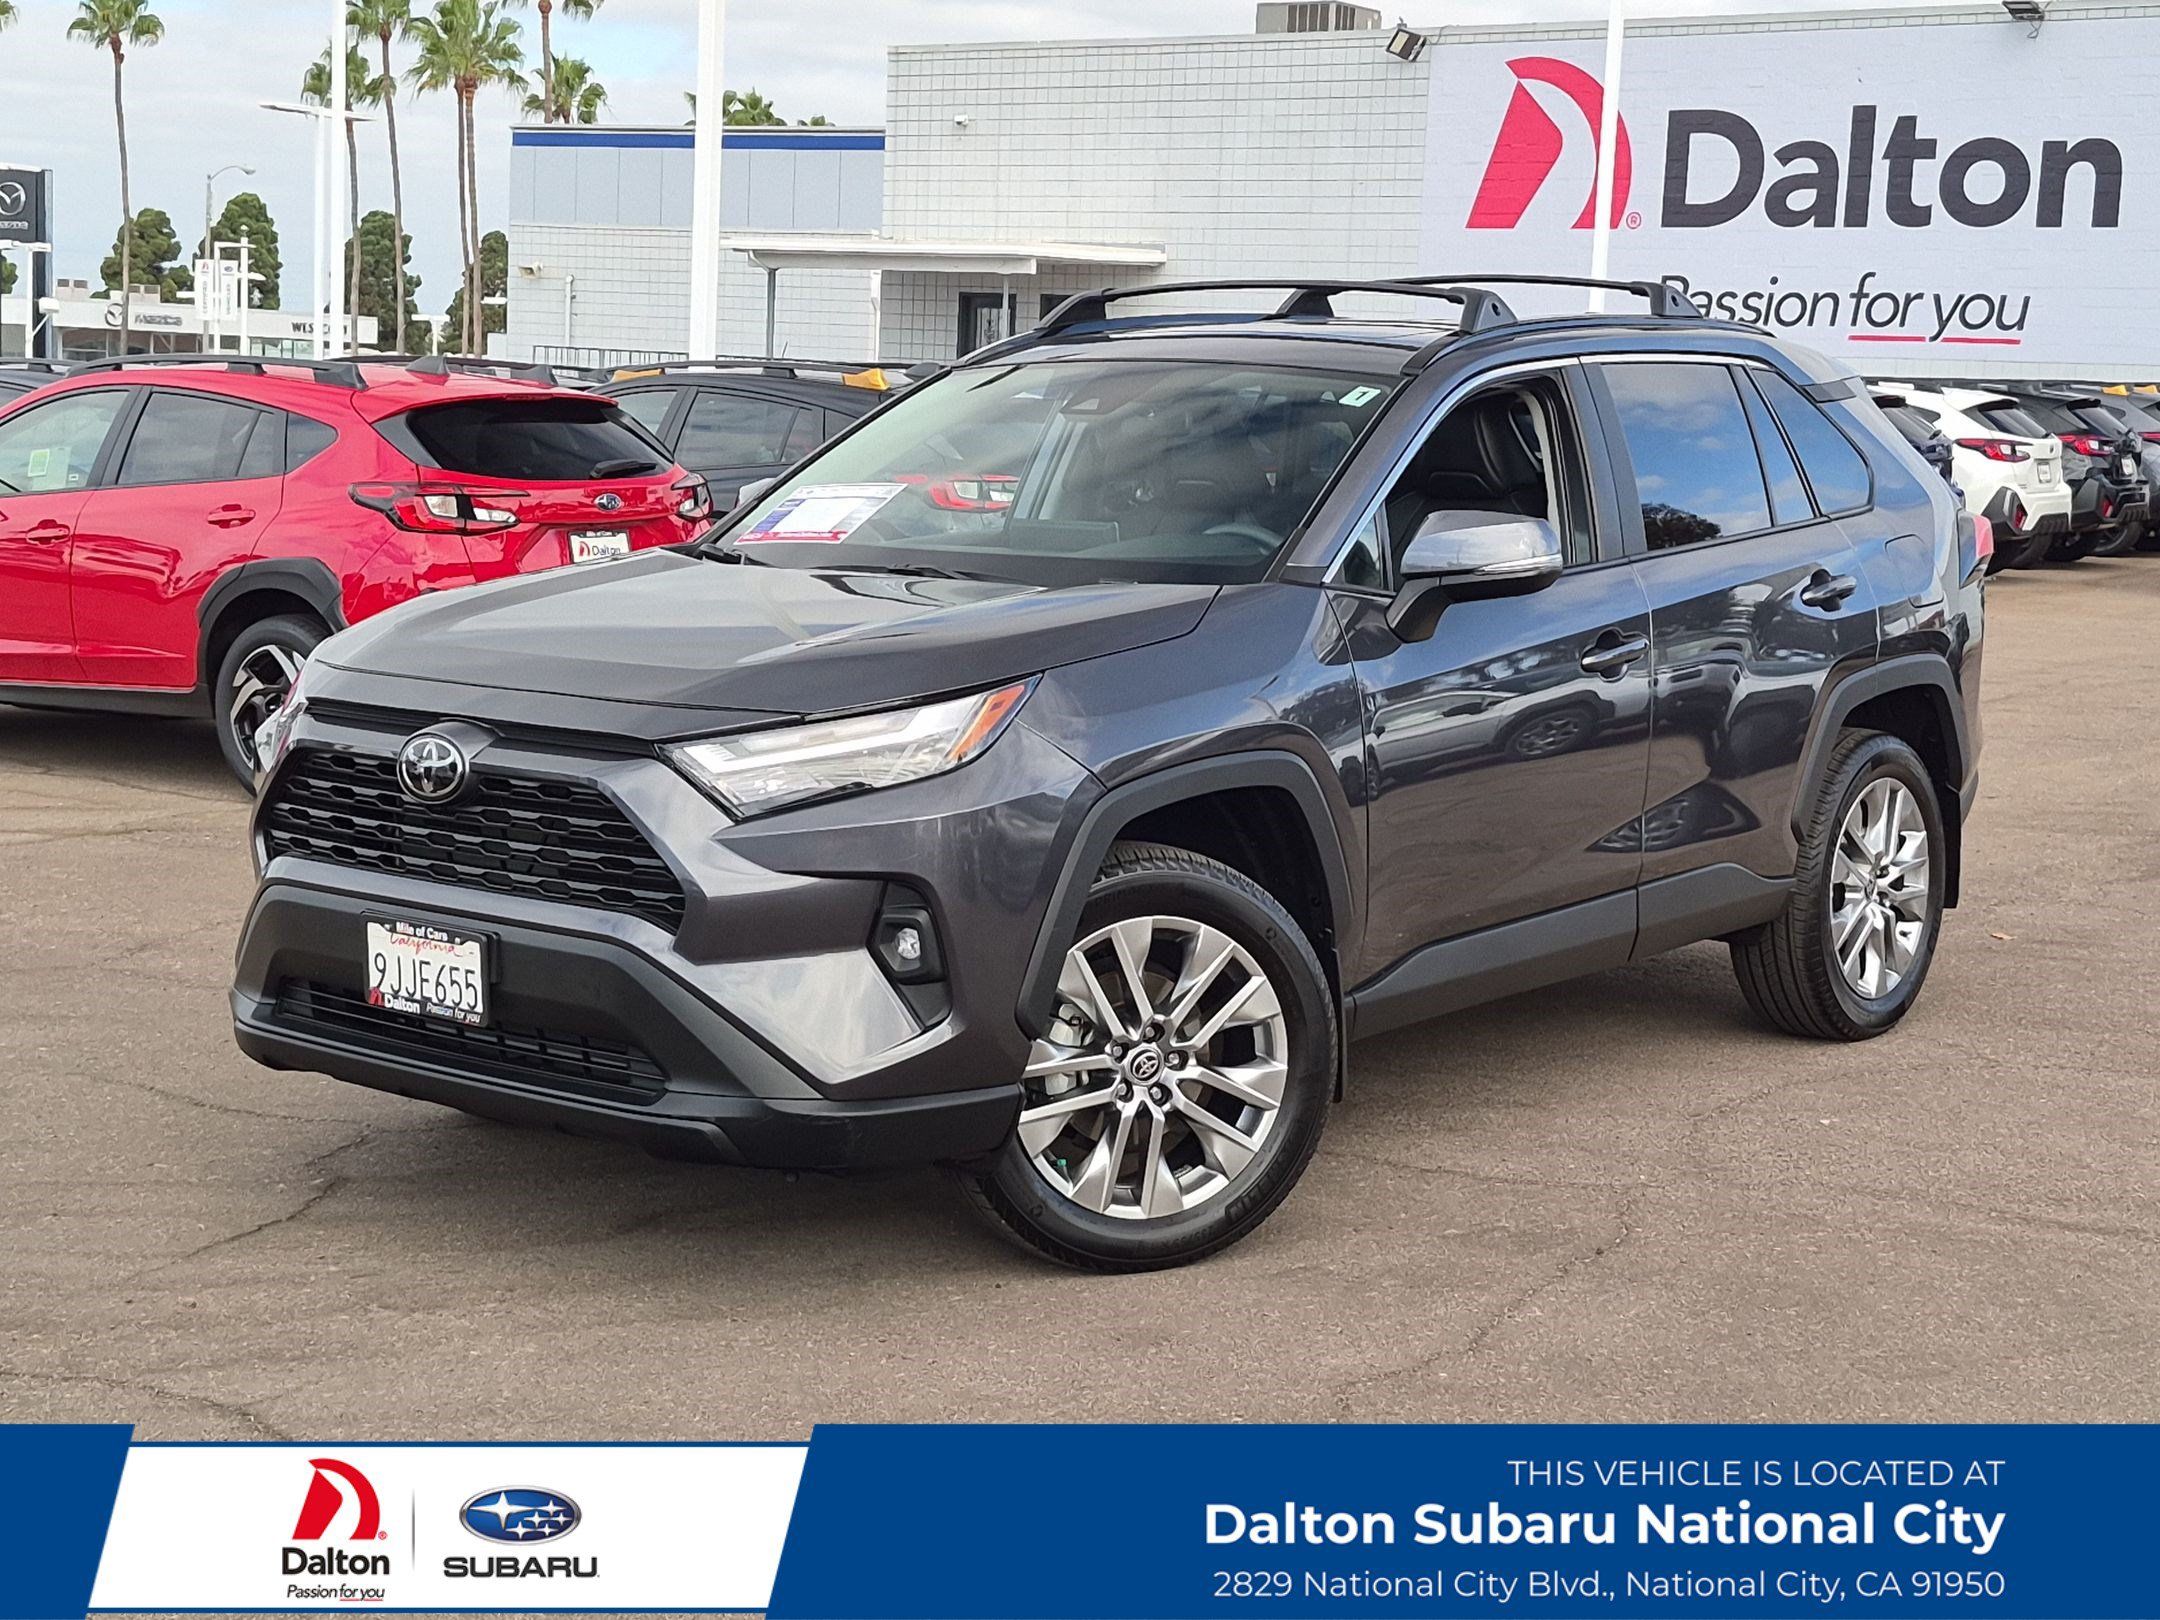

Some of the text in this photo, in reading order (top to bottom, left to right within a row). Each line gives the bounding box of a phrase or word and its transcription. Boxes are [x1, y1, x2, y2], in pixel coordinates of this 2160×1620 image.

[1661, 105, 2122, 228] Dalton
[1849, 272, 1924, 328] for
[1929, 293, 2031, 342] you
[591, 545, 621, 556] Dalton
[415, 926, 425, 937] of
[426, 927, 448, 942] Cars
[374, 952, 478, 1011] 9JJE655
[384, 992, 421, 1015] Dalton
